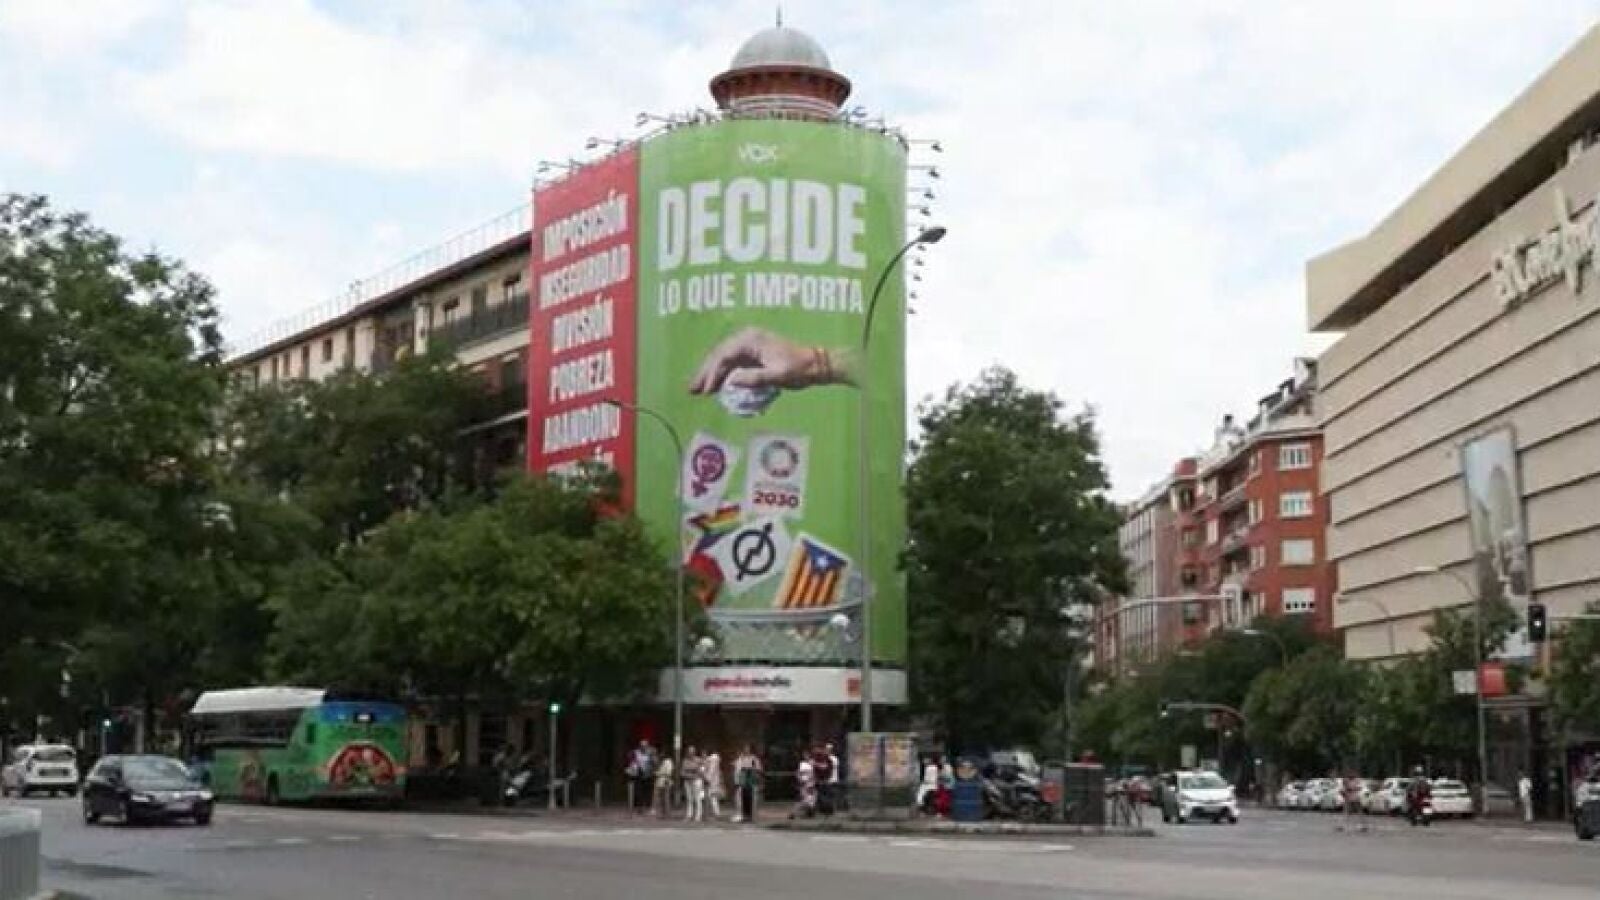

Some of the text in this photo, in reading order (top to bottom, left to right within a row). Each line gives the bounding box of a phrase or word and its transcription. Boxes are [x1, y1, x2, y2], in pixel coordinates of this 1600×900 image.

[658, 176, 867, 271] DECIDE
[659, 272, 864, 317] LO QUE IMPORTA
[550, 349, 615, 403] POBREZA
[543, 401, 621, 454] ABANDONO
[753, 490, 800, 509] 2030
